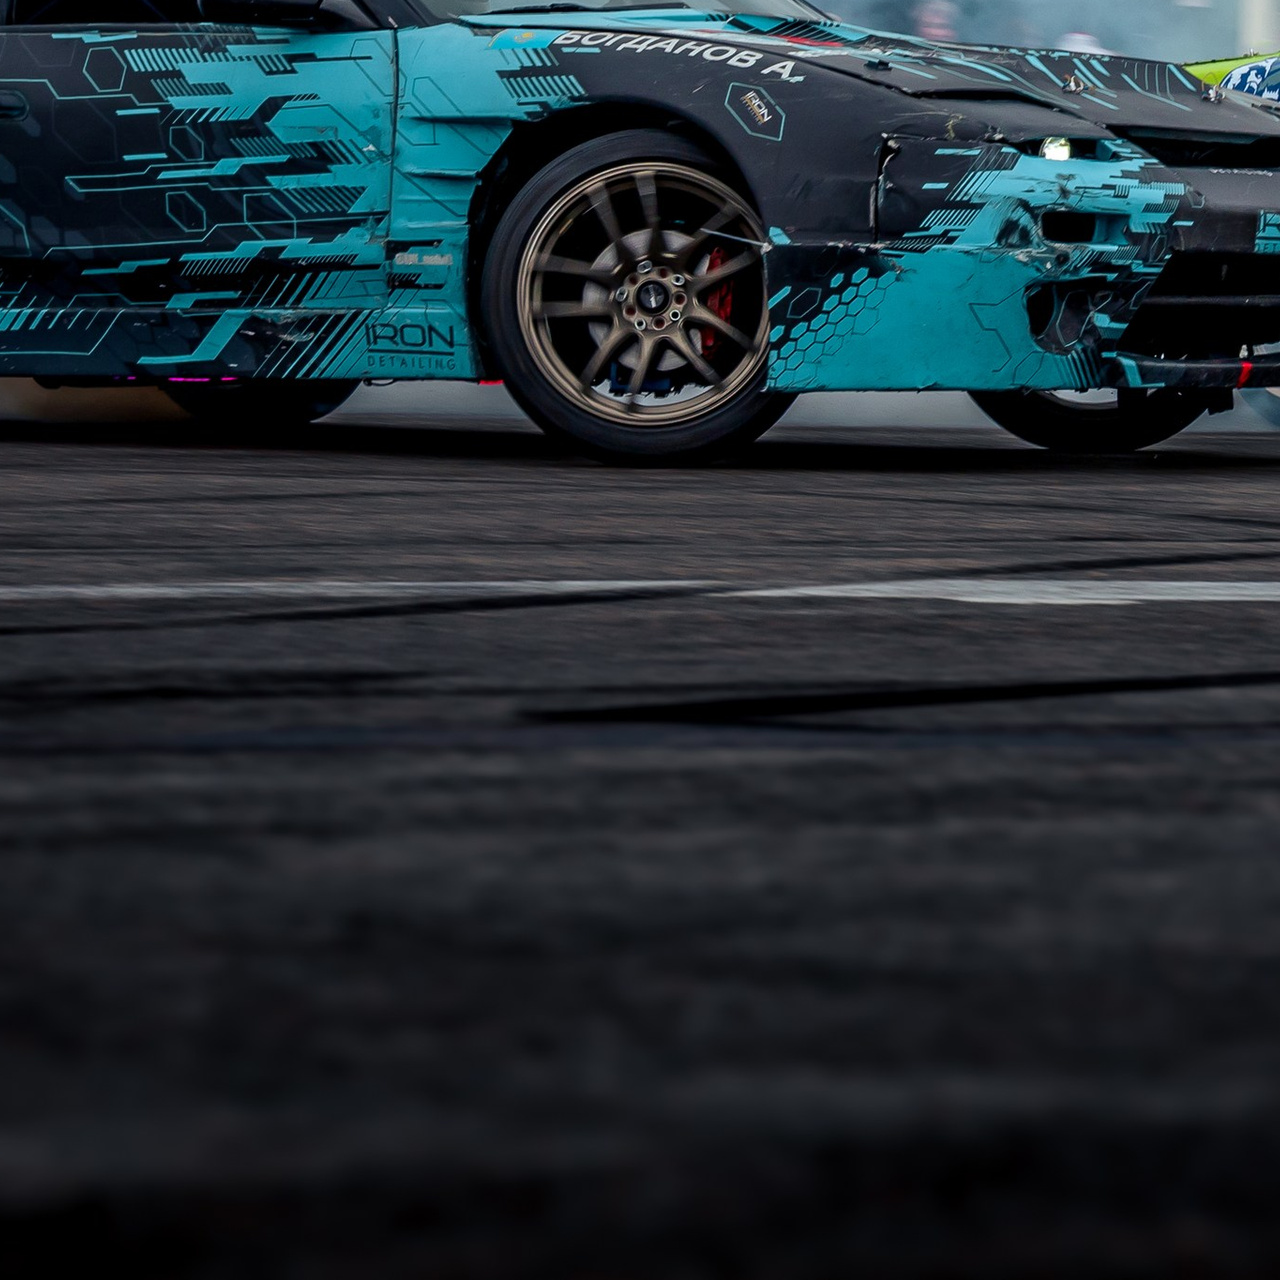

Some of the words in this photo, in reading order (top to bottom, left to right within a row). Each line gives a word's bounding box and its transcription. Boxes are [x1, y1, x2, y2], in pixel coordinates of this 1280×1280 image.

[553, 30, 764, 69] БОГДАНОВ
[364, 322, 455, 349] IRON
[366, 355, 456, 371] DETAILING
